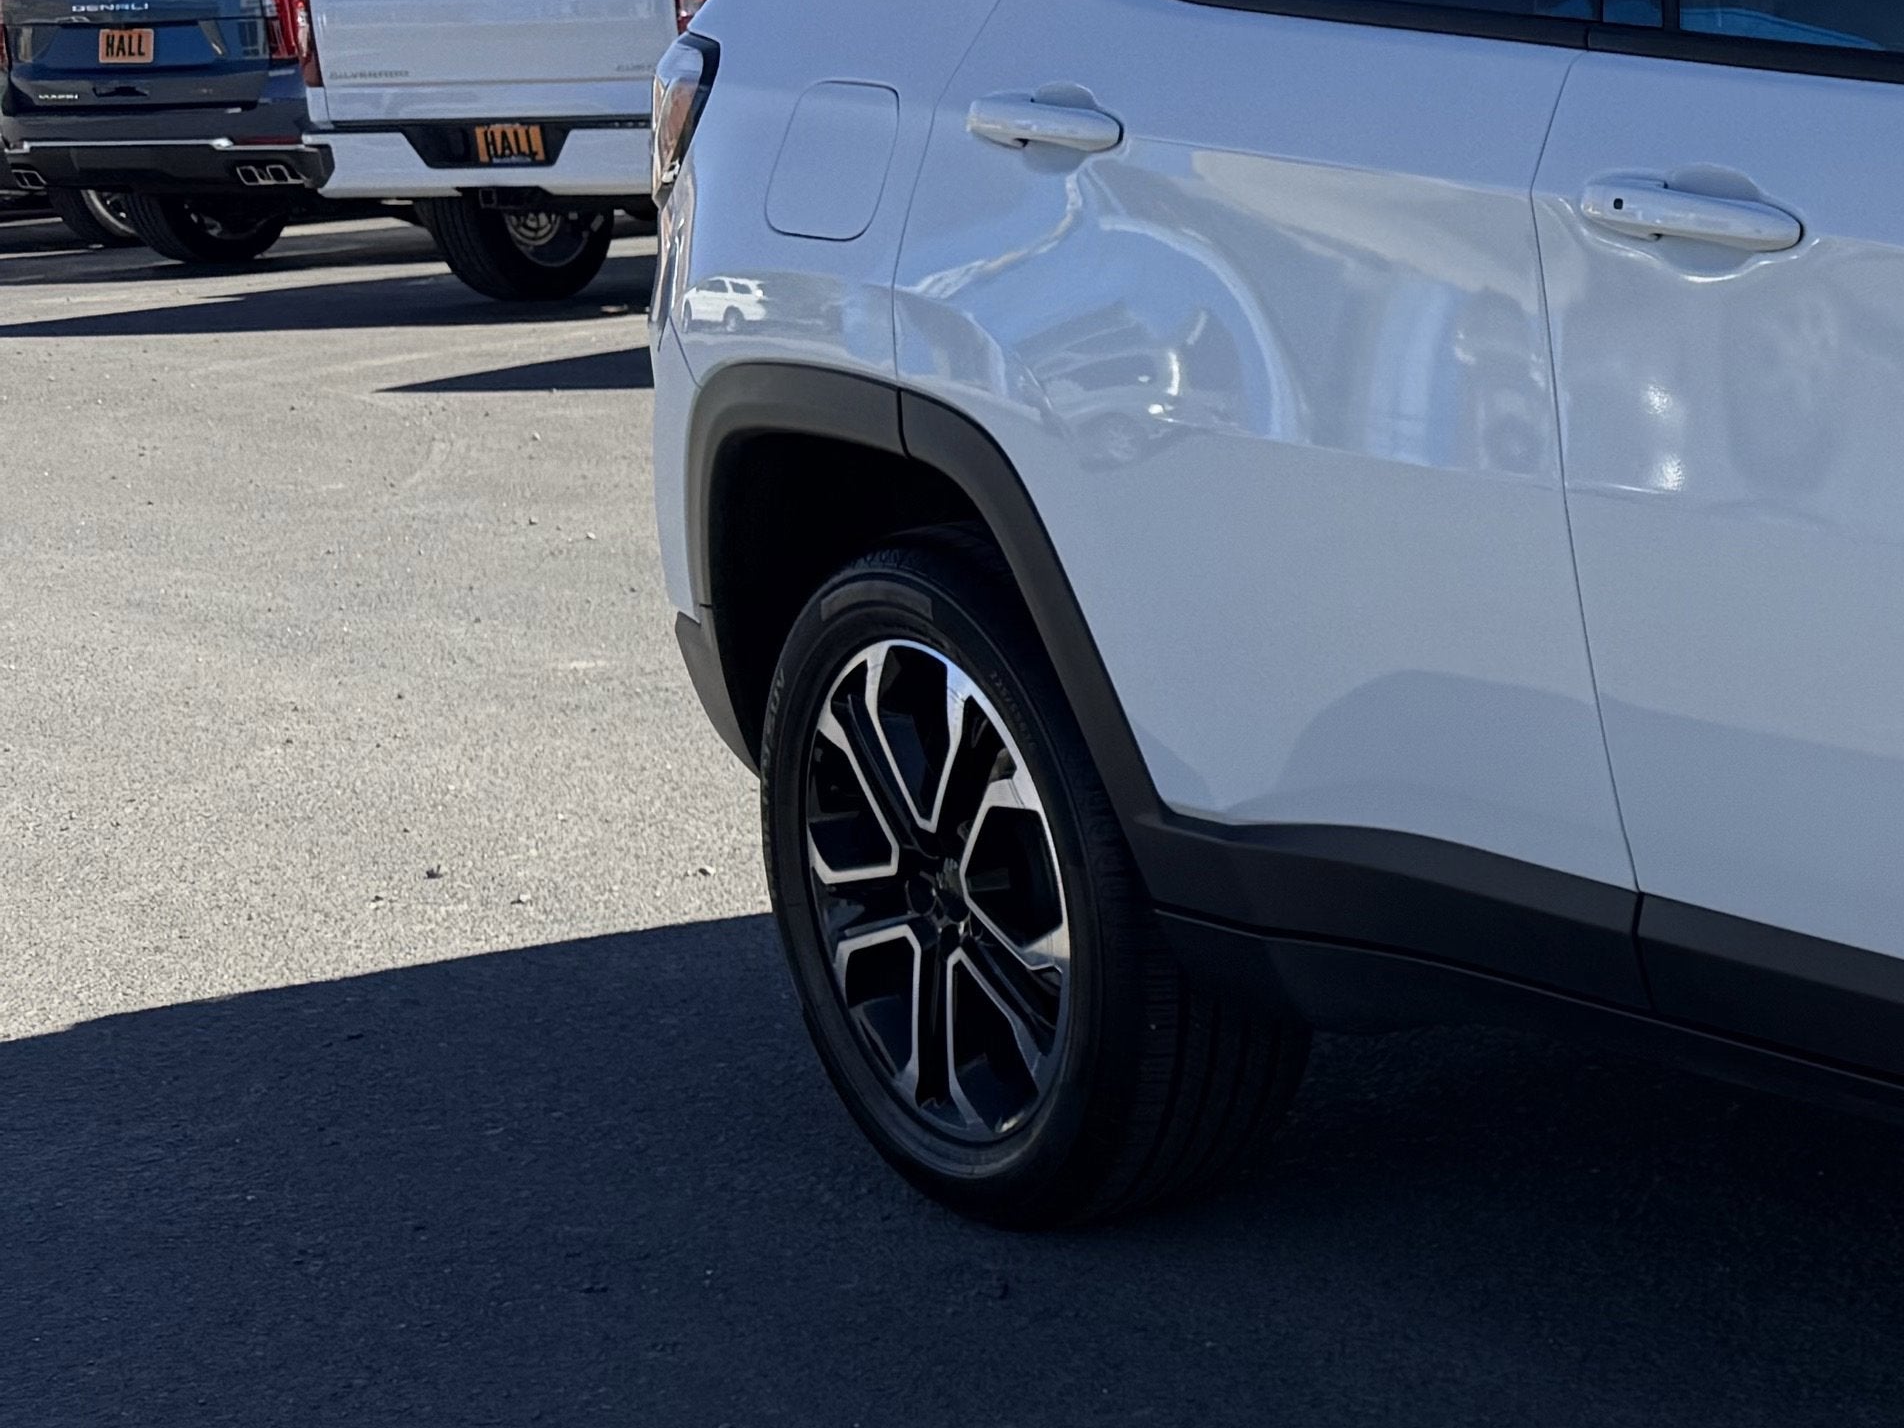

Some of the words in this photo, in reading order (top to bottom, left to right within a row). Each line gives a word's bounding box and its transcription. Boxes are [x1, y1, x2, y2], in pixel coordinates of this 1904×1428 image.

[71, 2, 149, 13] DENALI
[105, 33, 146, 58] HALL
[483, 129, 539, 160] HALL
